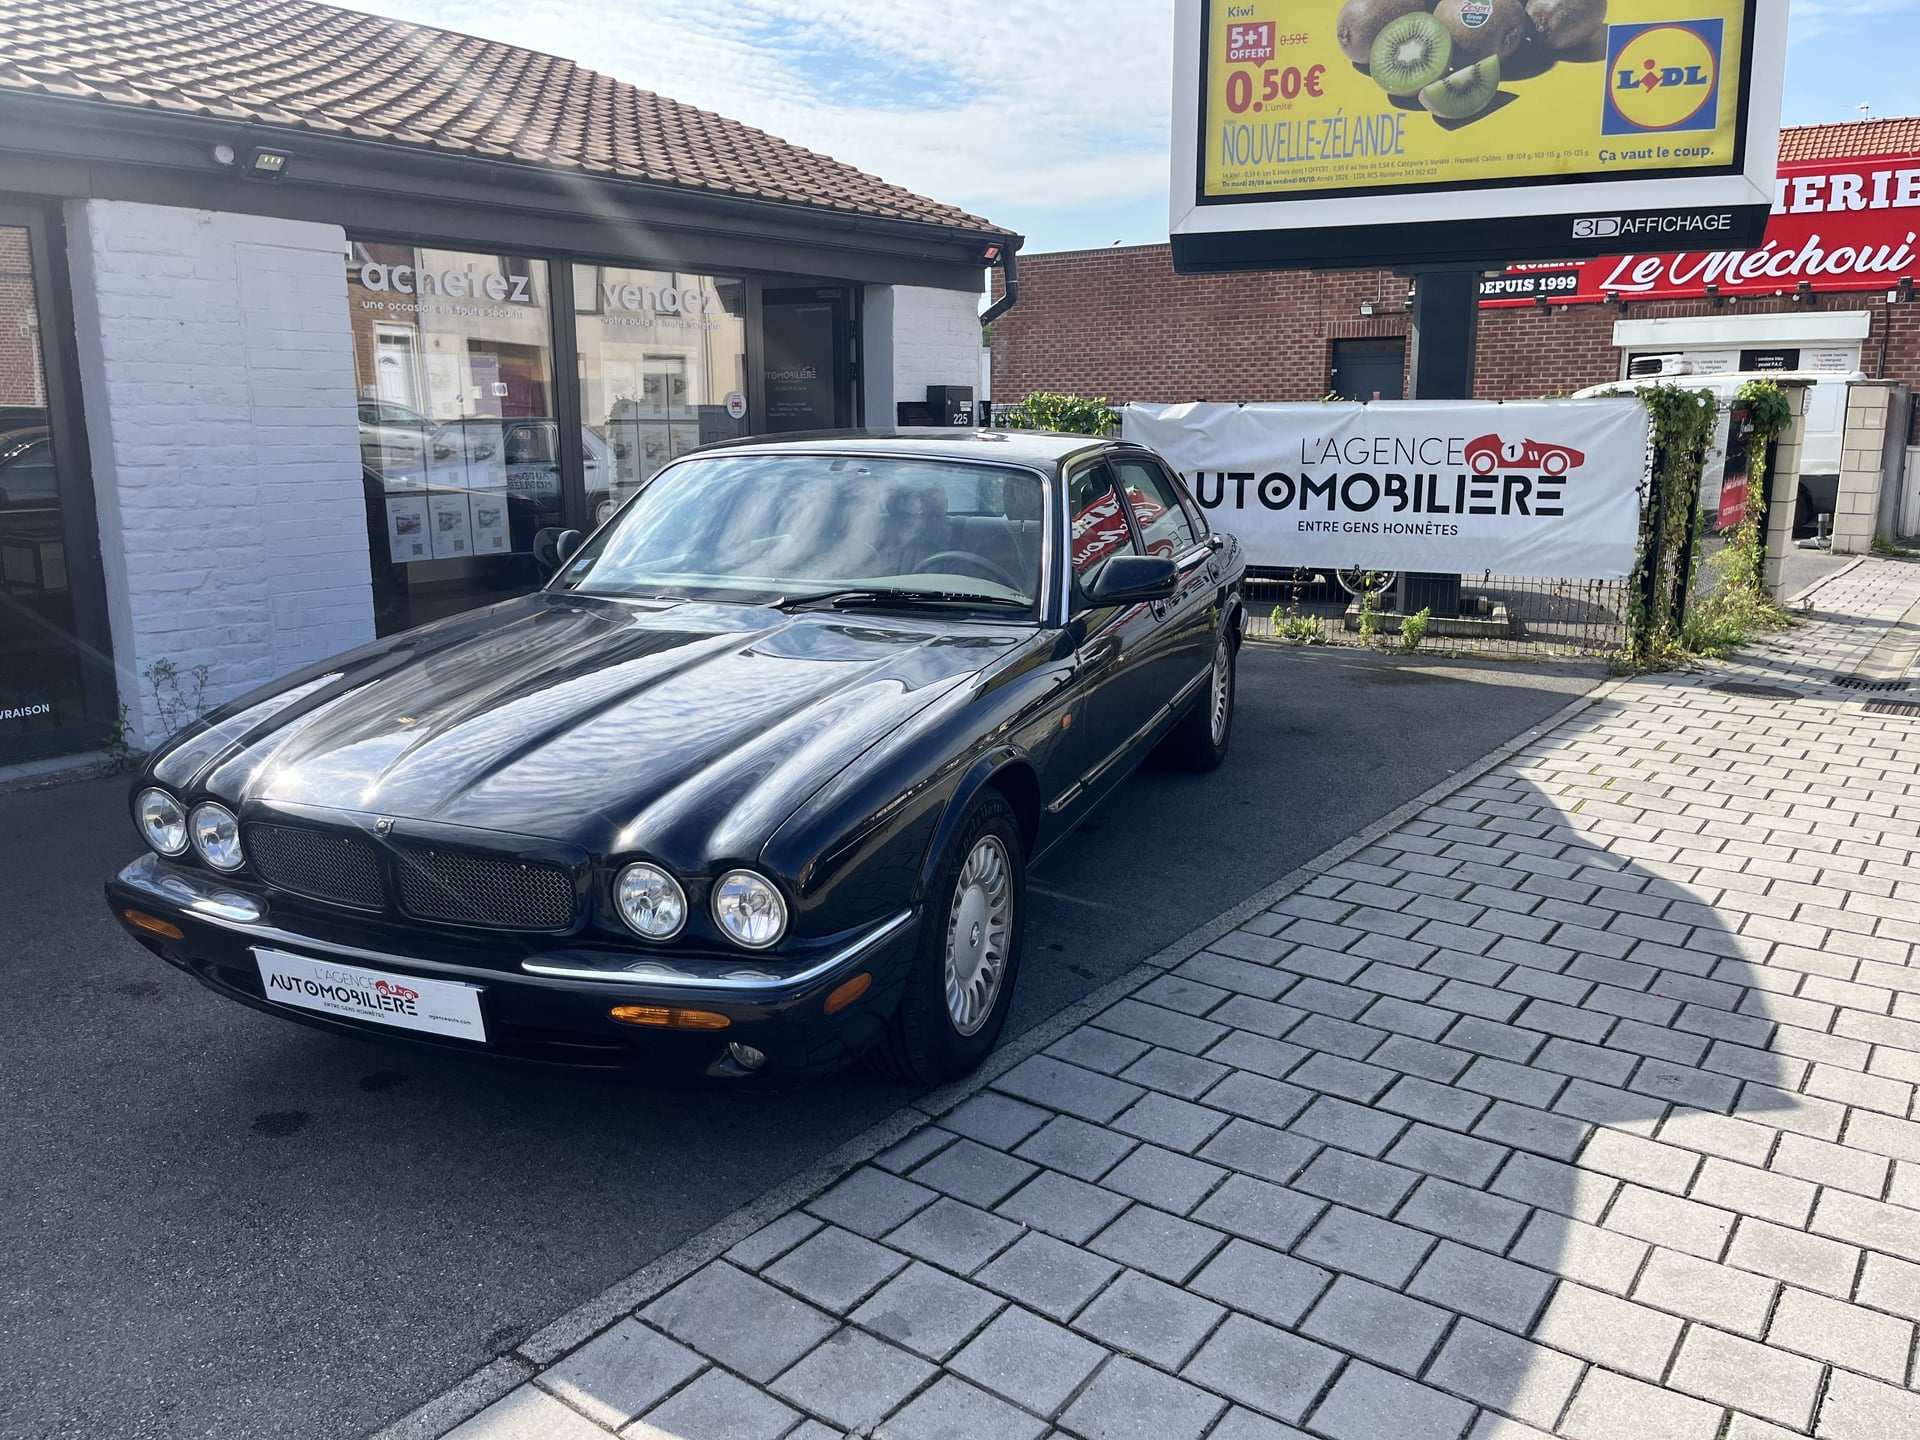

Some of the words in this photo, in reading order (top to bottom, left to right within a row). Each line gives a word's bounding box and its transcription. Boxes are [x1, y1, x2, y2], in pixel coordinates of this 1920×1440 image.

[1228, 5, 1255, 17] Kiwi
[1230, 25, 1269, 49] 5+1
[1230, 48, 1271, 59] OFFERT
[1221, 107, 1407, 166] NOUVELLE-ZÉLANDE
[1599, 150, 1617, 163] Ça
[1620, 149, 1653, 160] vaut
[1656, 146, 1670, 158] le
[1674, 147, 1714, 161] coup.
[1573, 219, 1620, 237] 3D
[1621, 214, 1731, 234] AFFICHAGE
[1598, 254, 1664, 292] Le
[1669, 231, 1917, 285] Méchoui
[360, 262, 530, 302] achetez
[1538, 276, 1577, 290] 1999
[362, 301, 384, 310] une
[388, 301, 437, 313] occasion
[602, 282, 718, 313] vendez
[603, 316, 627, 326] votre
[953, 413, 968, 425] 225
[1301, 437, 1465, 467] L'AGENCE
[1180, 470, 1567, 517] UTOMOBILIERE
[1297, 521, 1338, 533] ENTRE
[1342, 523, 1380, 534] GENS
[1383, 519, 1458, 536] HONNÊTES
[314, 967, 376, 990] L'AGENCE
[323, 1001, 340, 1010] ENTRE
[341, 1004, 354, 1012] GENS
